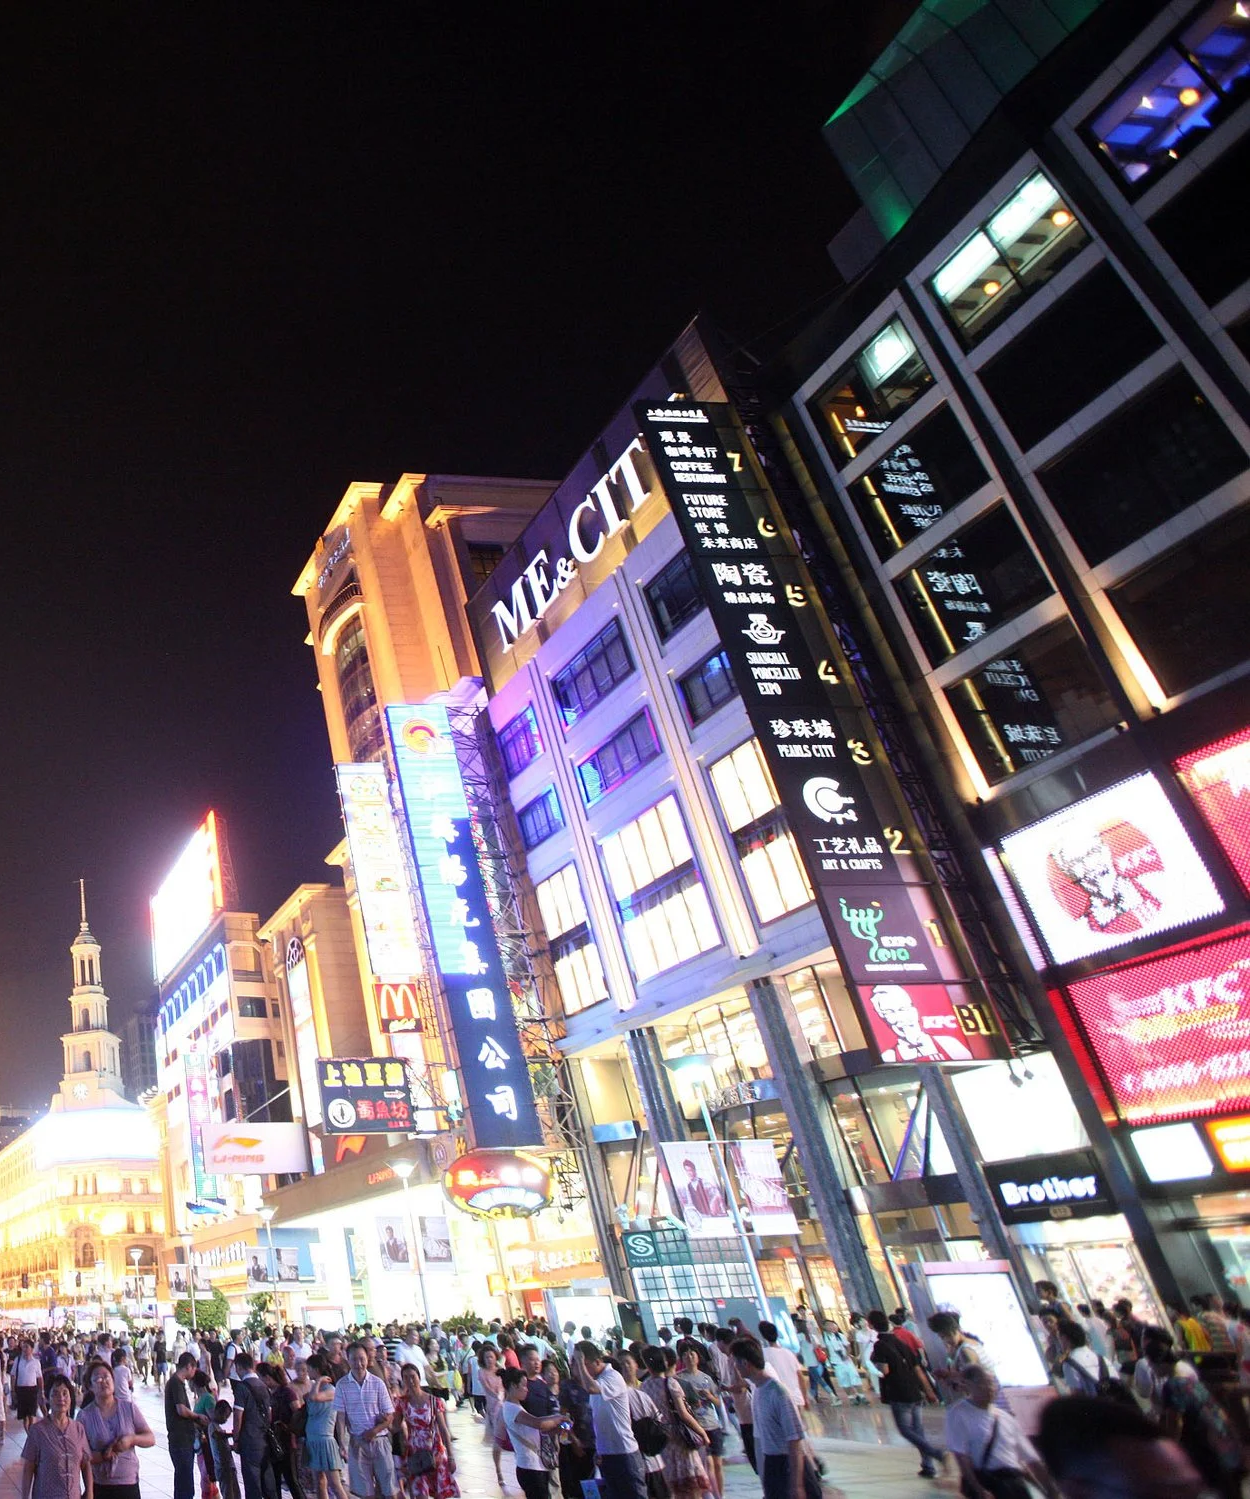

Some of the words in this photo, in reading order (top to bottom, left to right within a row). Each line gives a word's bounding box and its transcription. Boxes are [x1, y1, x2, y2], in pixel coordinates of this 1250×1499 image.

[670, 461, 714, 472] COFFEE
[682, 493, 729, 506] FUTURE
[687, 507, 726, 519] STORE
[491, 433, 651, 654] ME&CIT
[701, 537, 758, 549] 未来商店
[711, 563, 773, 586] 陶瓷
[785, 584, 808, 607] 5
[746, 652, 790, 665] SHANGHAI
[751, 667, 801, 680] PORCELAIN
[818, 660, 841, 684] 4
[757, 683, 782, 695] EXPO
[769, 718, 836, 738] 珍珠城
[777, 744, 812, 757] PEARLS
[813, 744, 836, 757] CITY
[847, 738, 874, 765] 3
[812, 837, 883, 854] 工艺礼品
[883, 827, 913, 854] 2
[822, 859, 839, 870] ART
[849, 858, 883, 870] CRAFTS
[921, 1015, 957, 1029] KFC
[953, 1004, 996, 1036] B1
[212, 1153, 266, 1164] LI-NING
[1000, 1174, 1097, 1206] Brother
